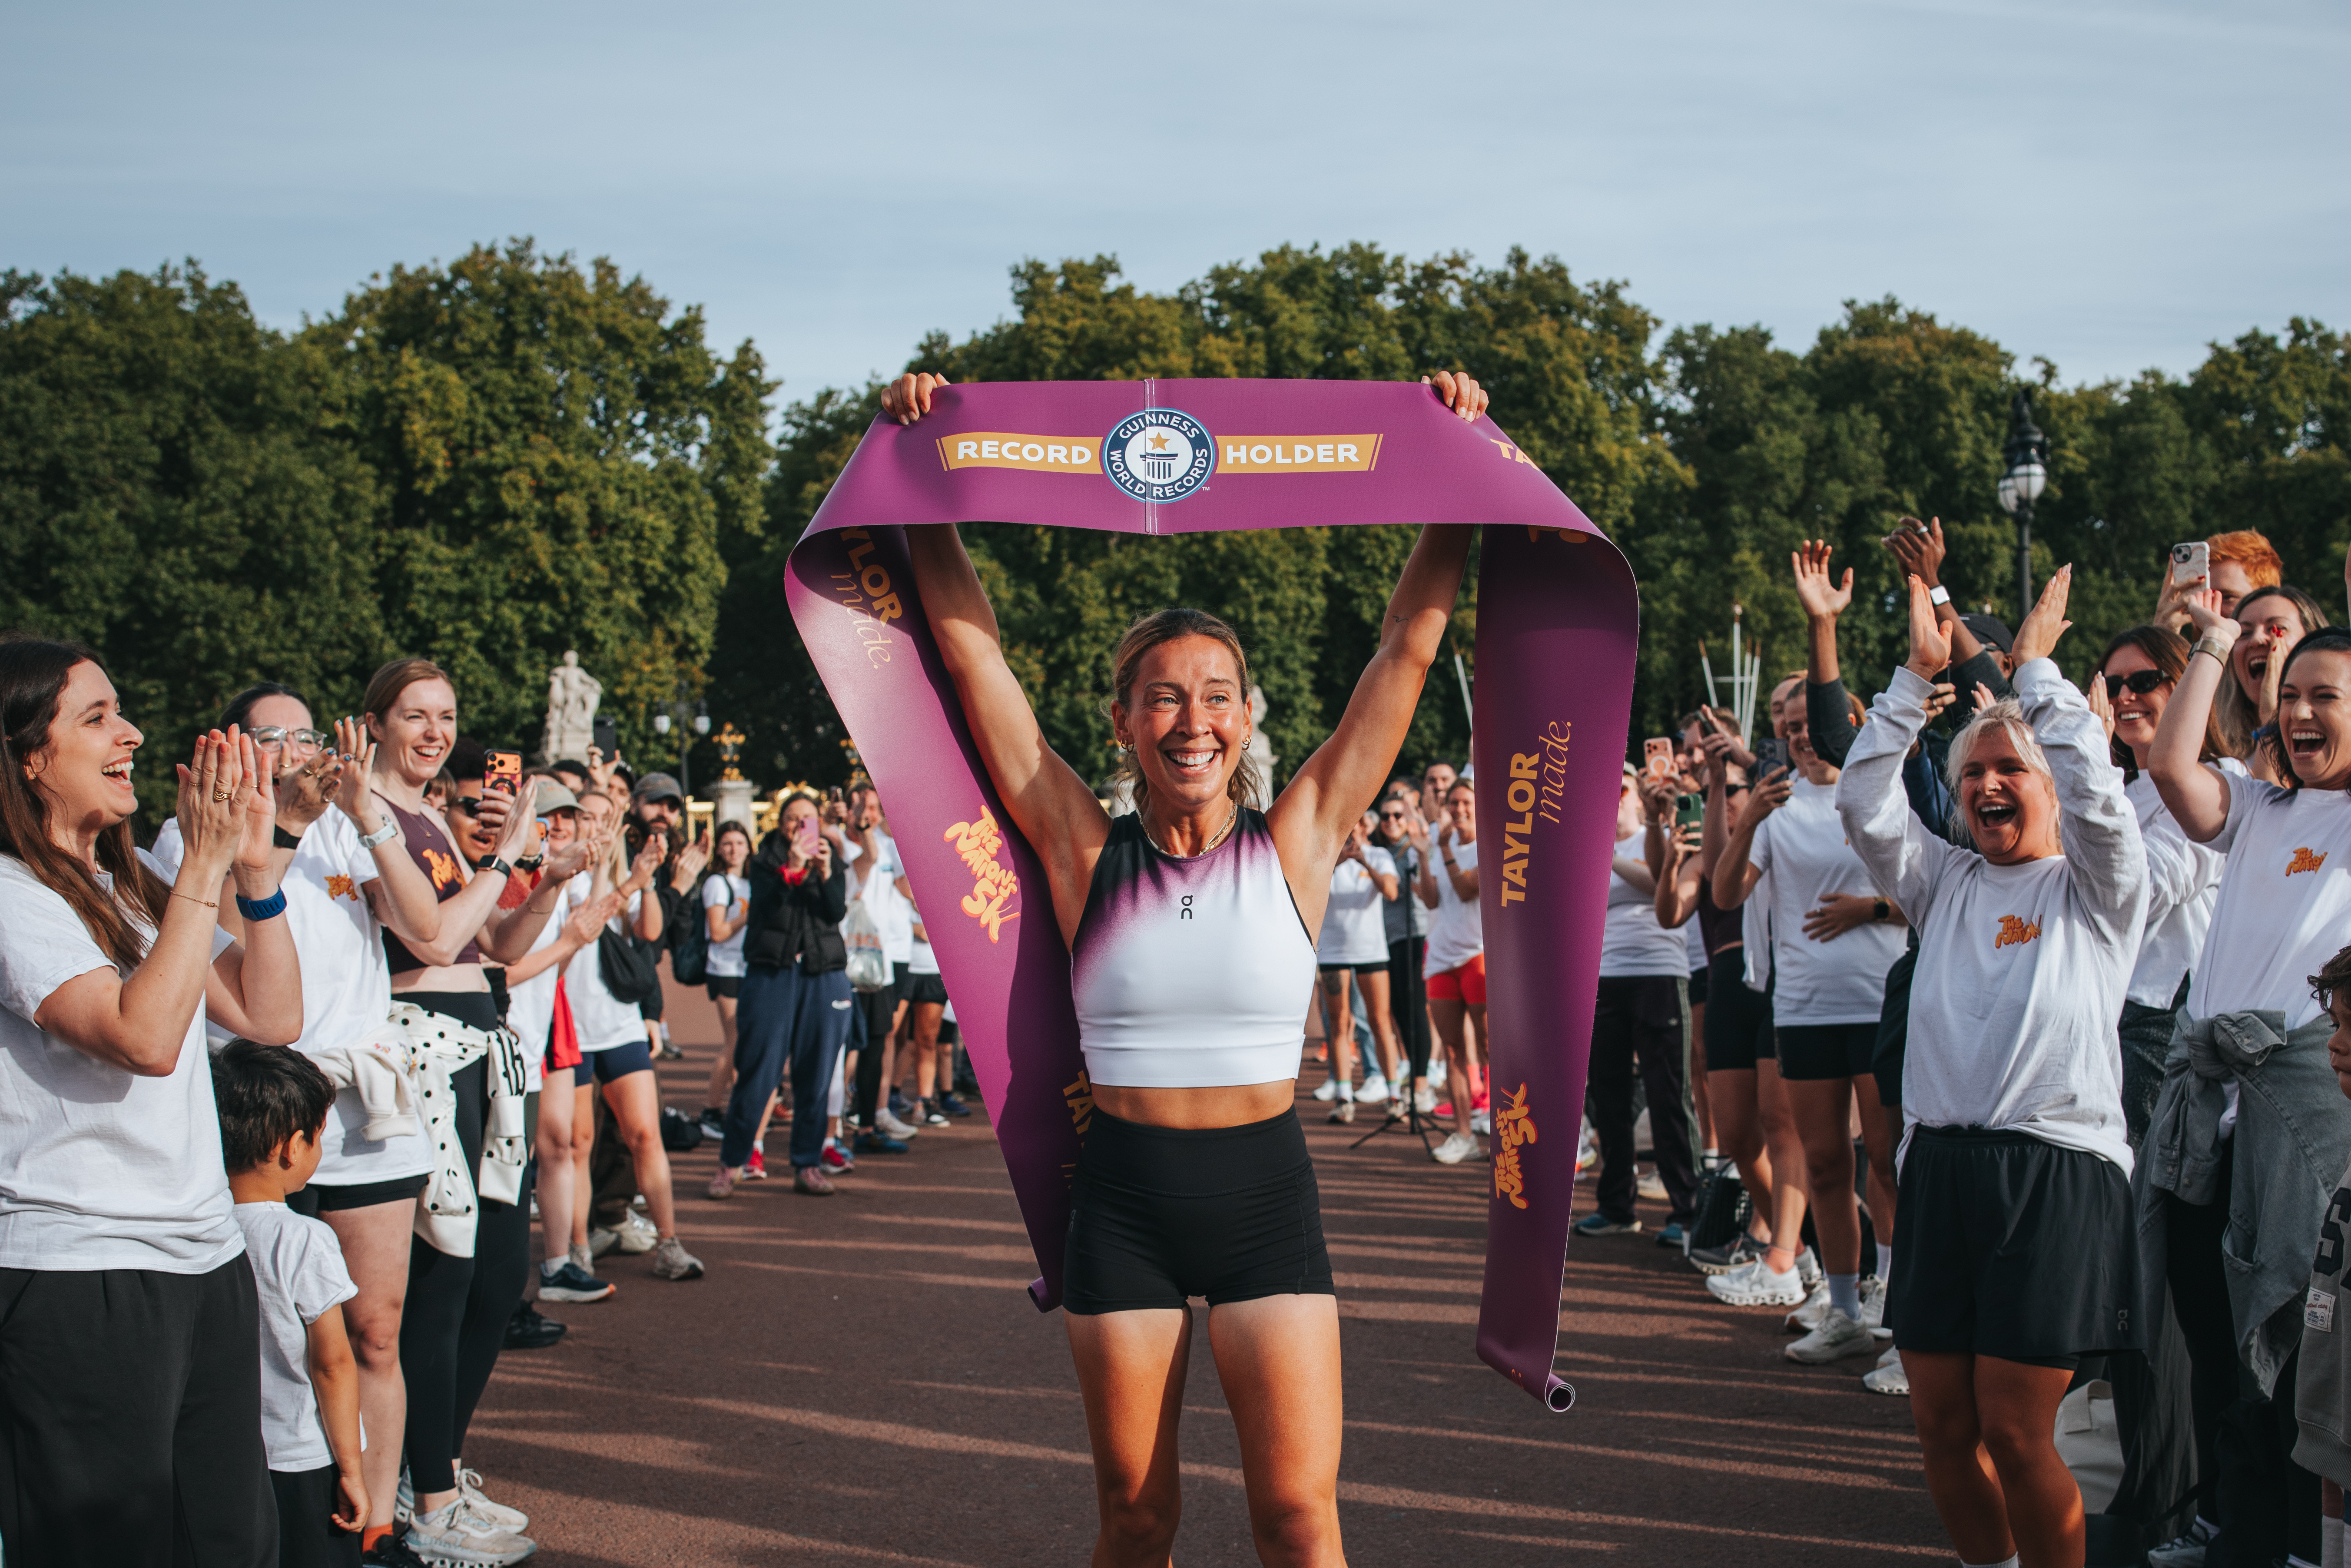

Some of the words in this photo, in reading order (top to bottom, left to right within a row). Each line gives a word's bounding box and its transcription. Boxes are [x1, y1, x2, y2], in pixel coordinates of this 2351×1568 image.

[1119, 414, 1200, 439] GUINNESS
[957, 440, 1092, 464] RECORD
[1226, 444, 1360, 464] HOLDER
[1110, 450, 1145, 494] WORLD
[1153, 449, 1207, 497] RECORDS
[970, 805, 1002, 857] THE
[1501, 753, 1539, 907] TAYLOR
[943, 821, 1017, 901] NATION'S
[1495, 1152, 1512, 1199] THE
